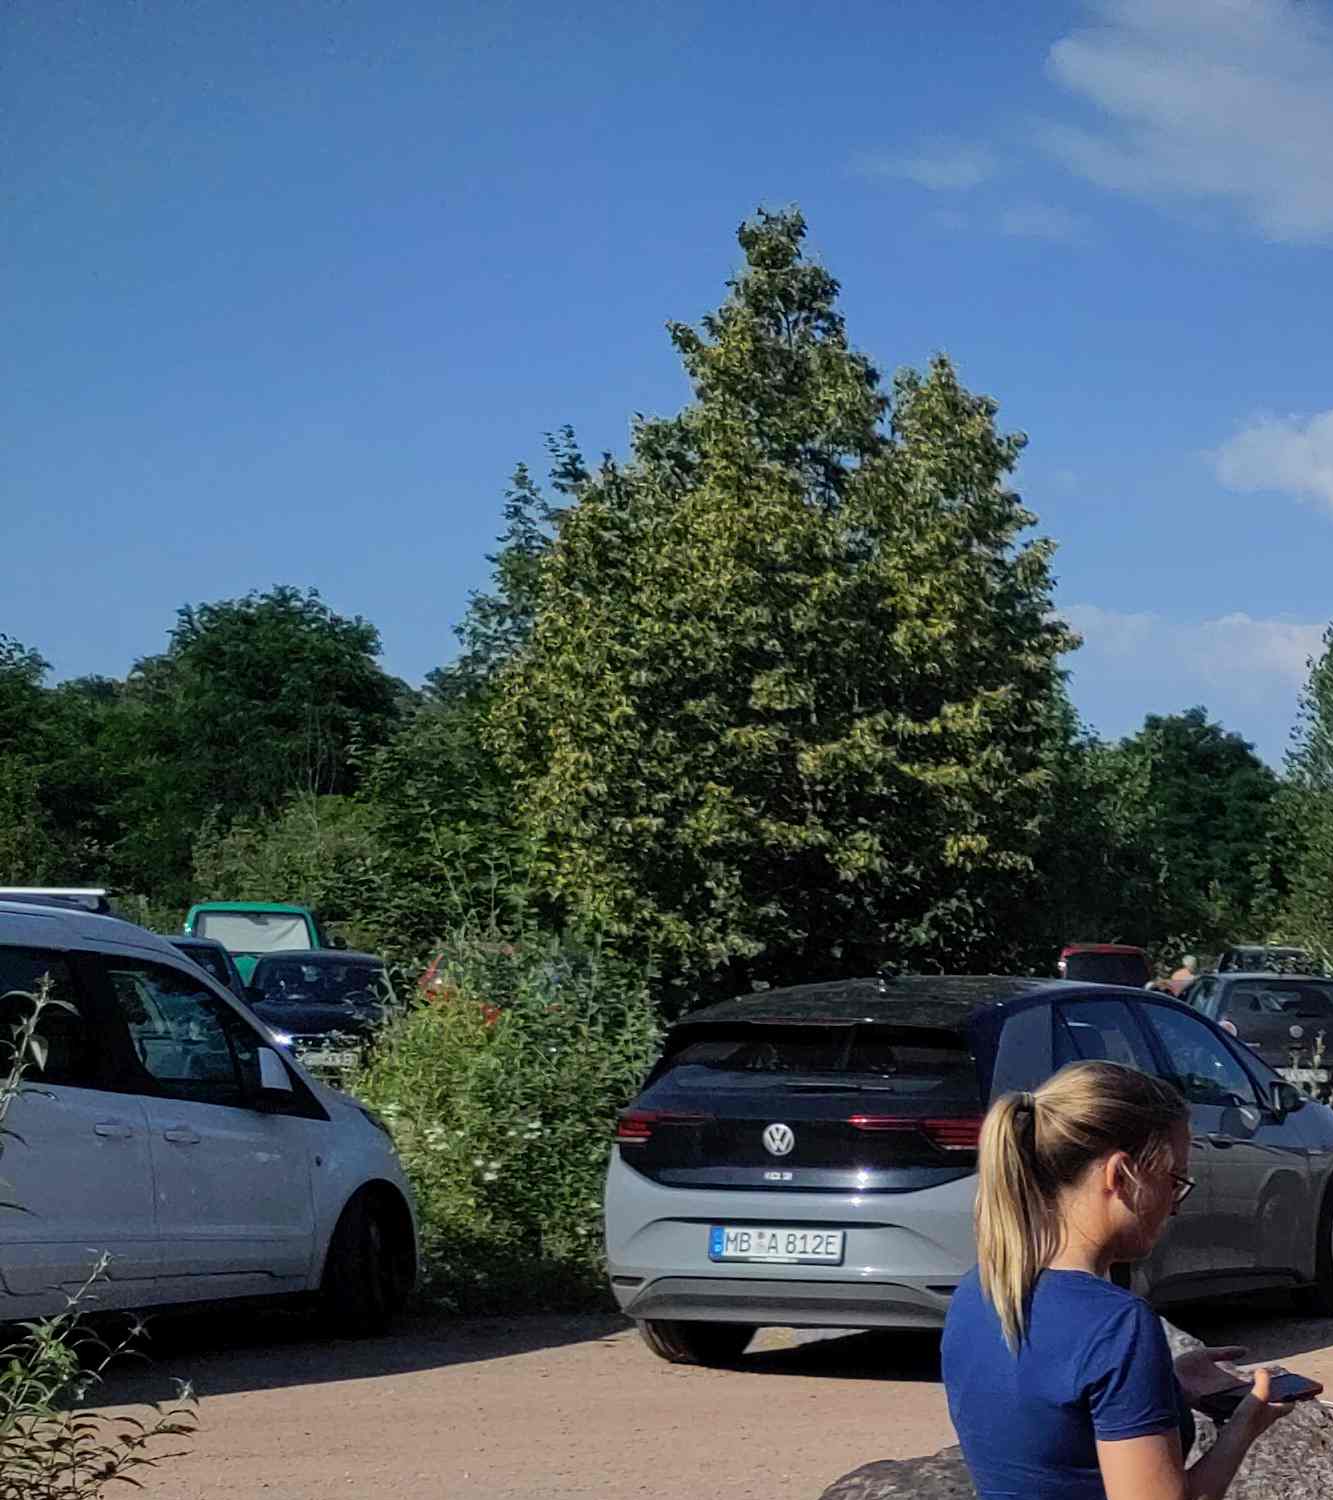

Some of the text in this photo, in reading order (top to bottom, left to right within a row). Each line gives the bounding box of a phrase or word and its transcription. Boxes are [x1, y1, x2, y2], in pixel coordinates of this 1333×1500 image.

[726, 1232, 838, 1255] MB A 812E
